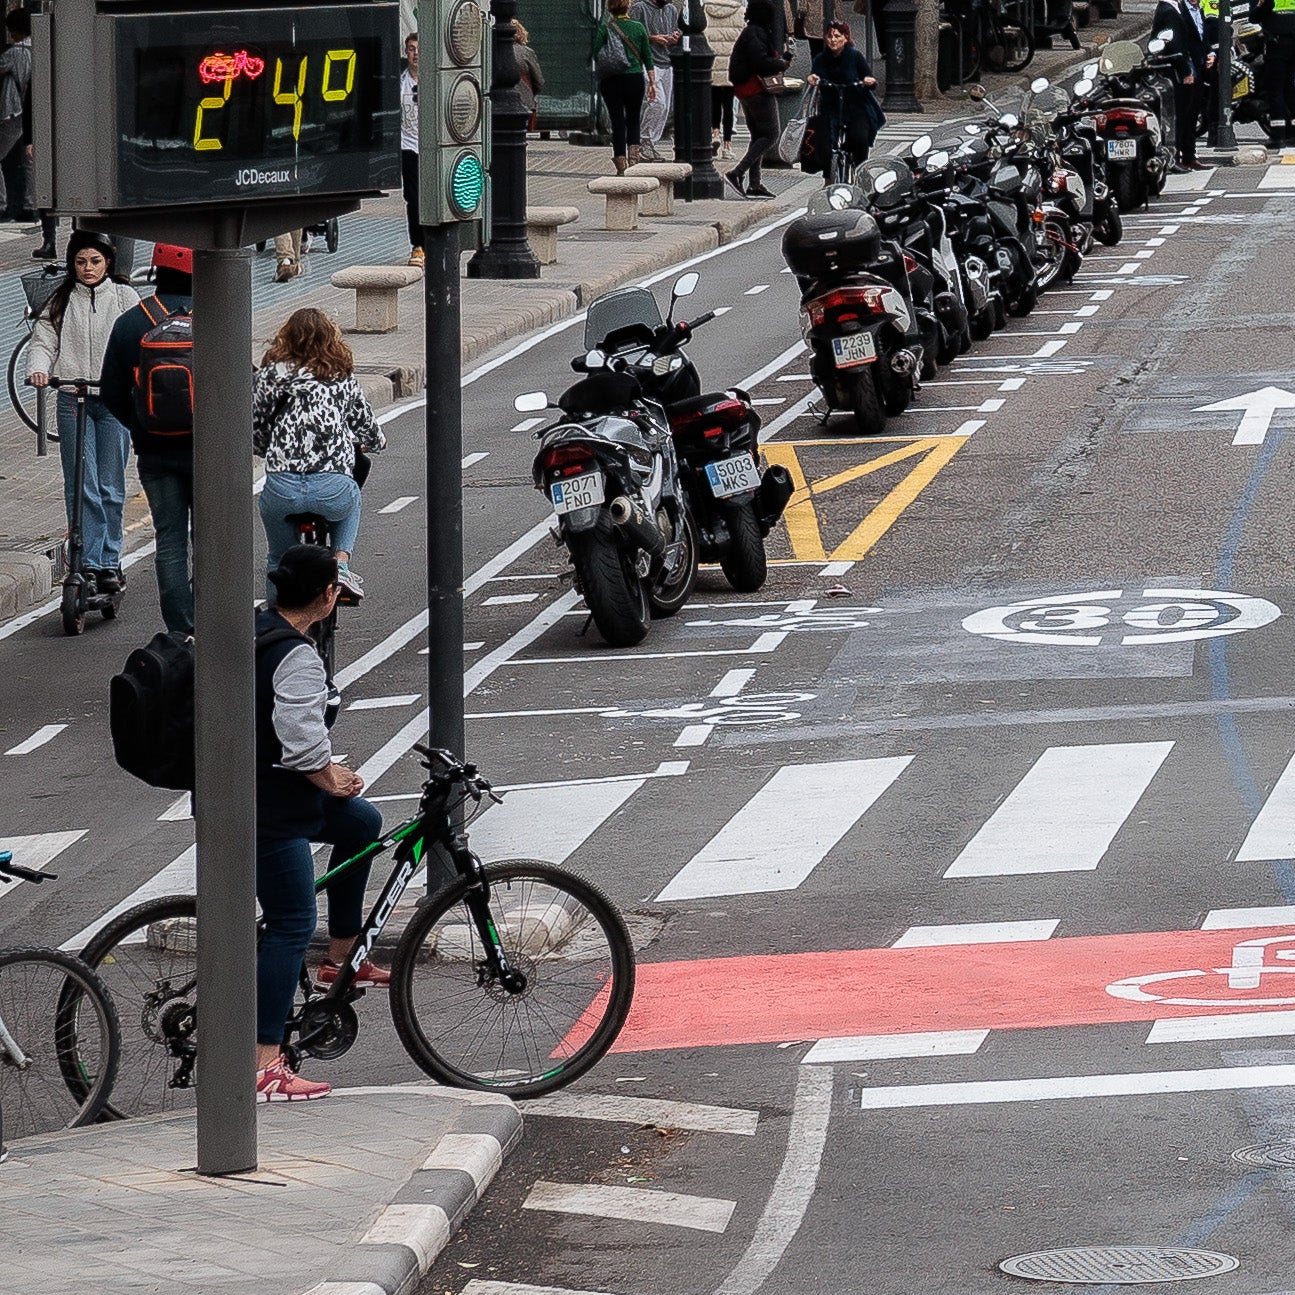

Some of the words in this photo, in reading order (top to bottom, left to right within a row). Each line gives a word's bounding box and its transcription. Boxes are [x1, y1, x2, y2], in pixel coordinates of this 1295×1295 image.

[236, 168, 290, 186] JCDecaux
[842, 334, 871, 350] 2239
[846, 346, 867, 361] JHN
[716, 458, 752, 478] 5003
[563, 475, 598, 495] 2071
[722, 474, 749, 492] MKS
[564, 492, 592, 510] FND
[1019, 602, 1222, 631] 30
[351, 860, 414, 973] RACER
